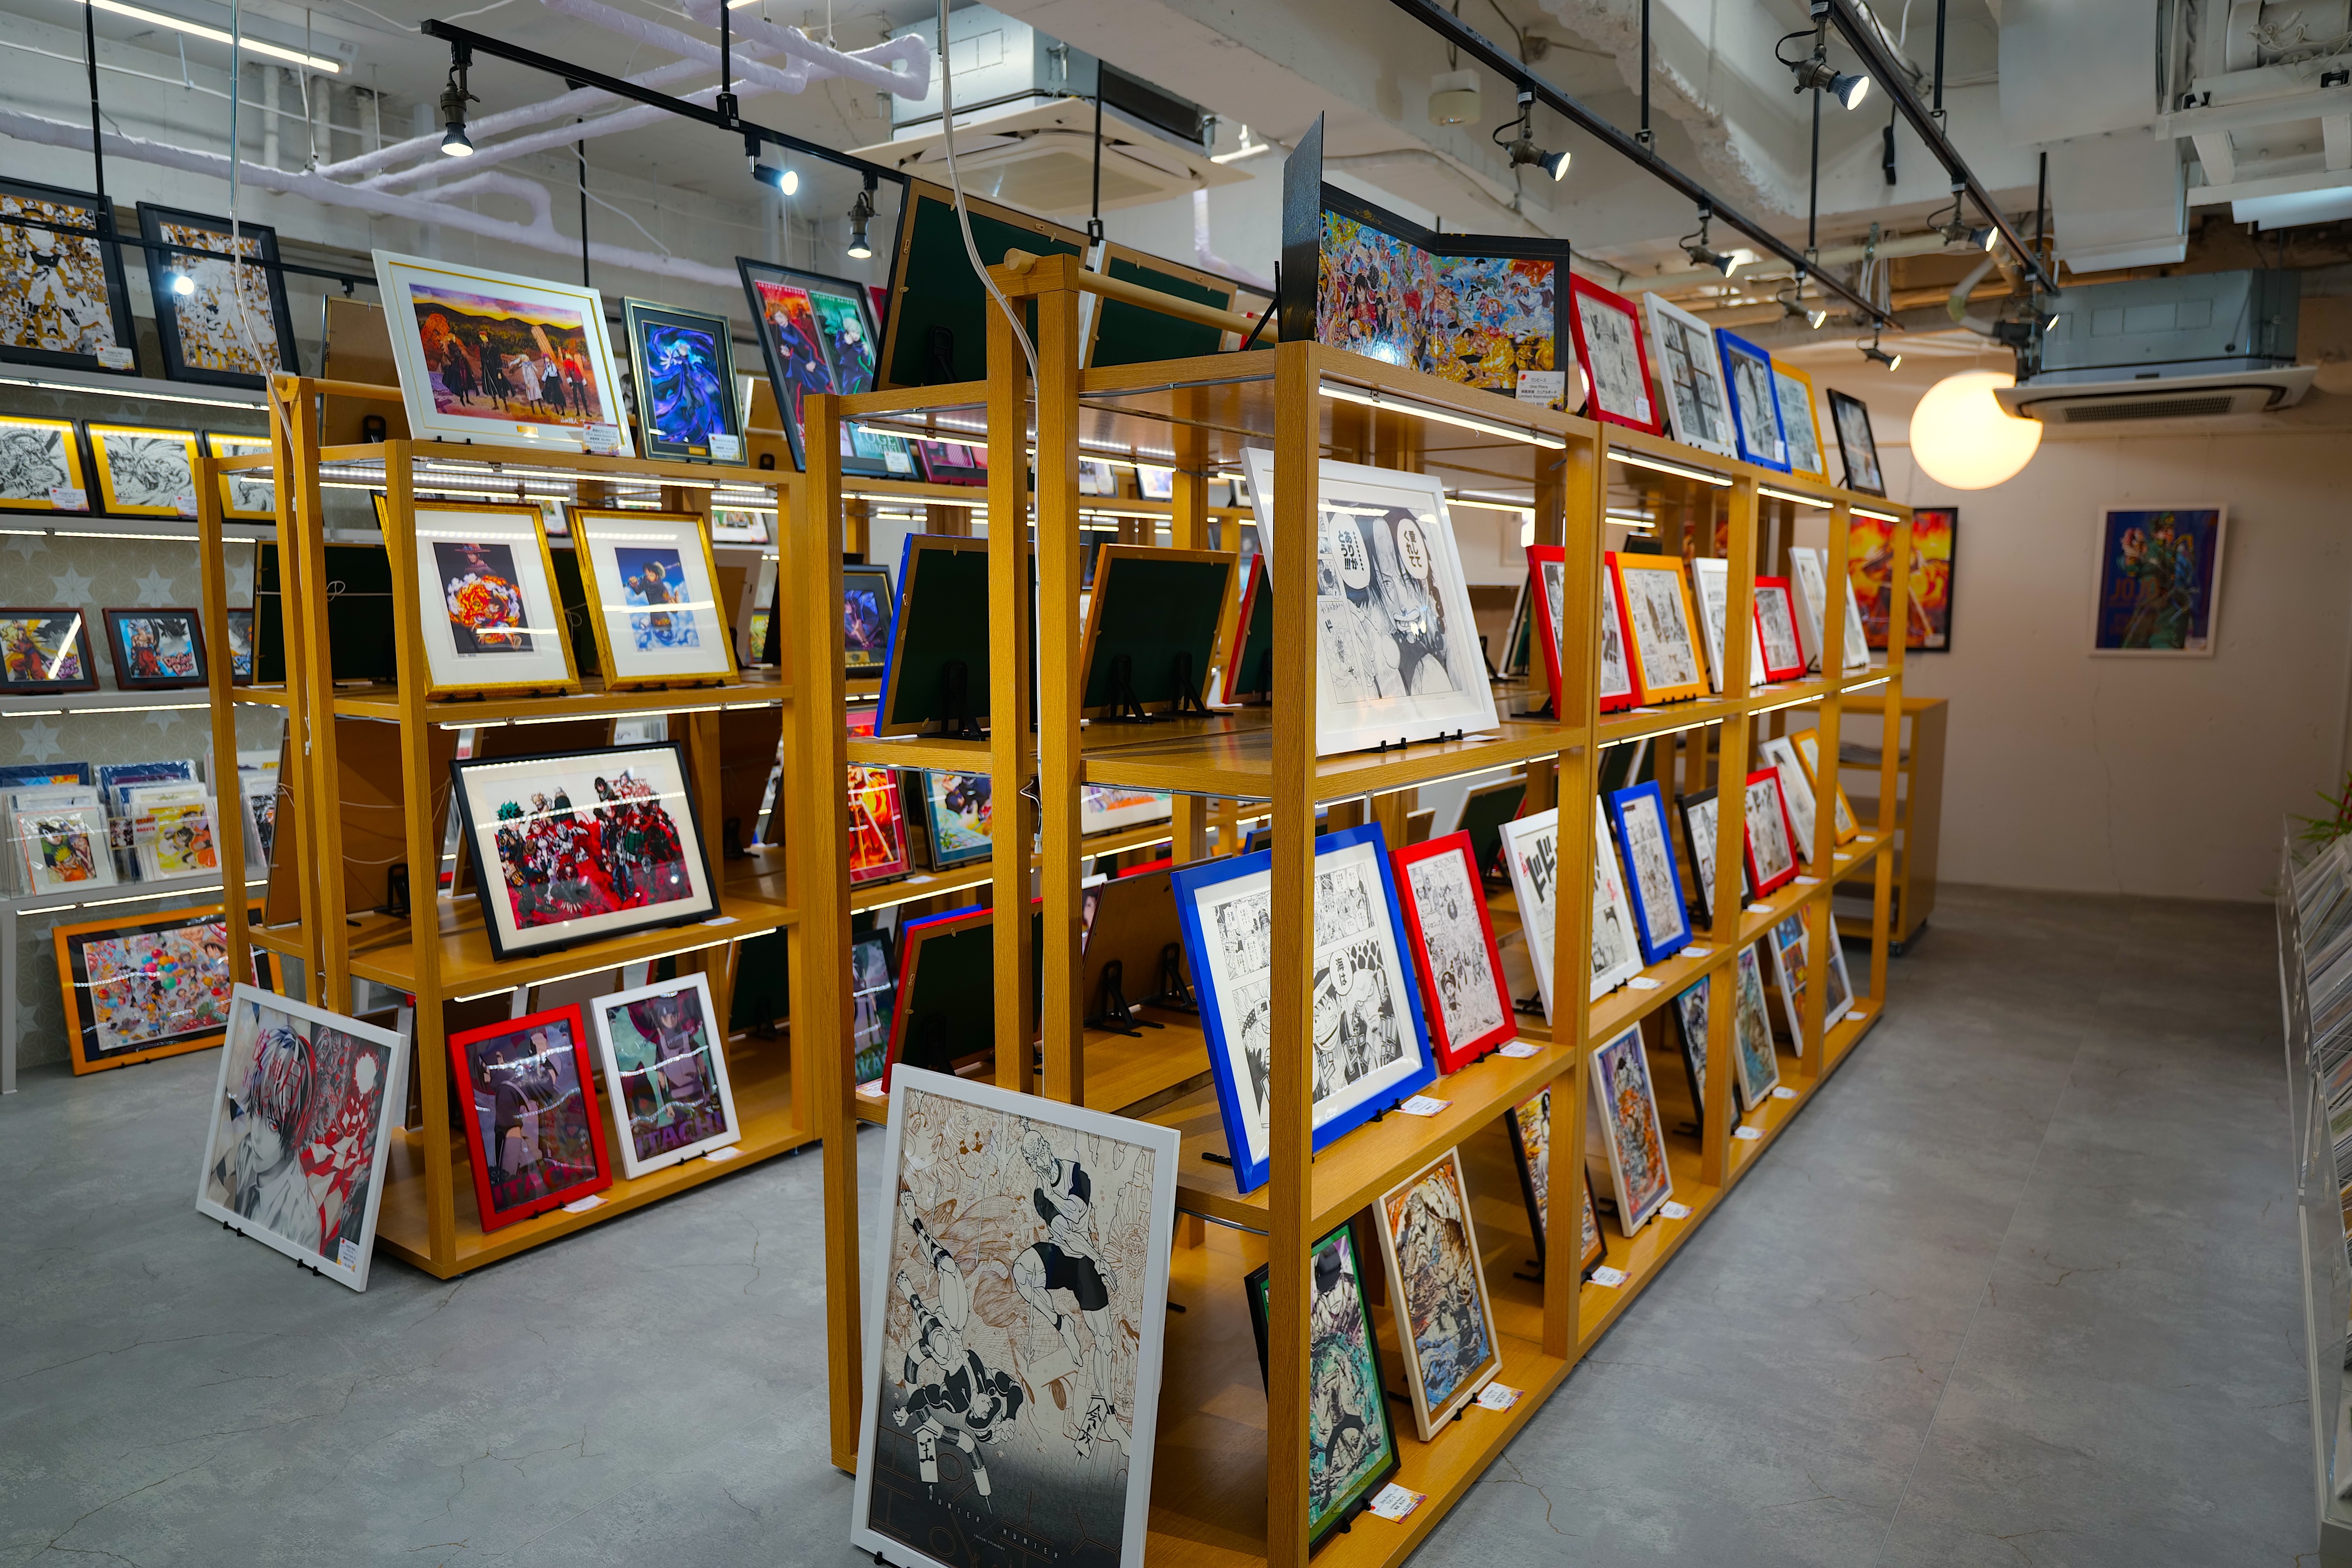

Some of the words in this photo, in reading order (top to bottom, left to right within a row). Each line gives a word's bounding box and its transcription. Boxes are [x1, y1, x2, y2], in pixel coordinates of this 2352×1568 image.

[635, 1110, 724, 1157] ITACHI
[493, 1154, 593, 1208] ITACHI
[929, 1494, 980, 1523] HUNTER
[1003, 1528, 1058, 1559] HUNTER
